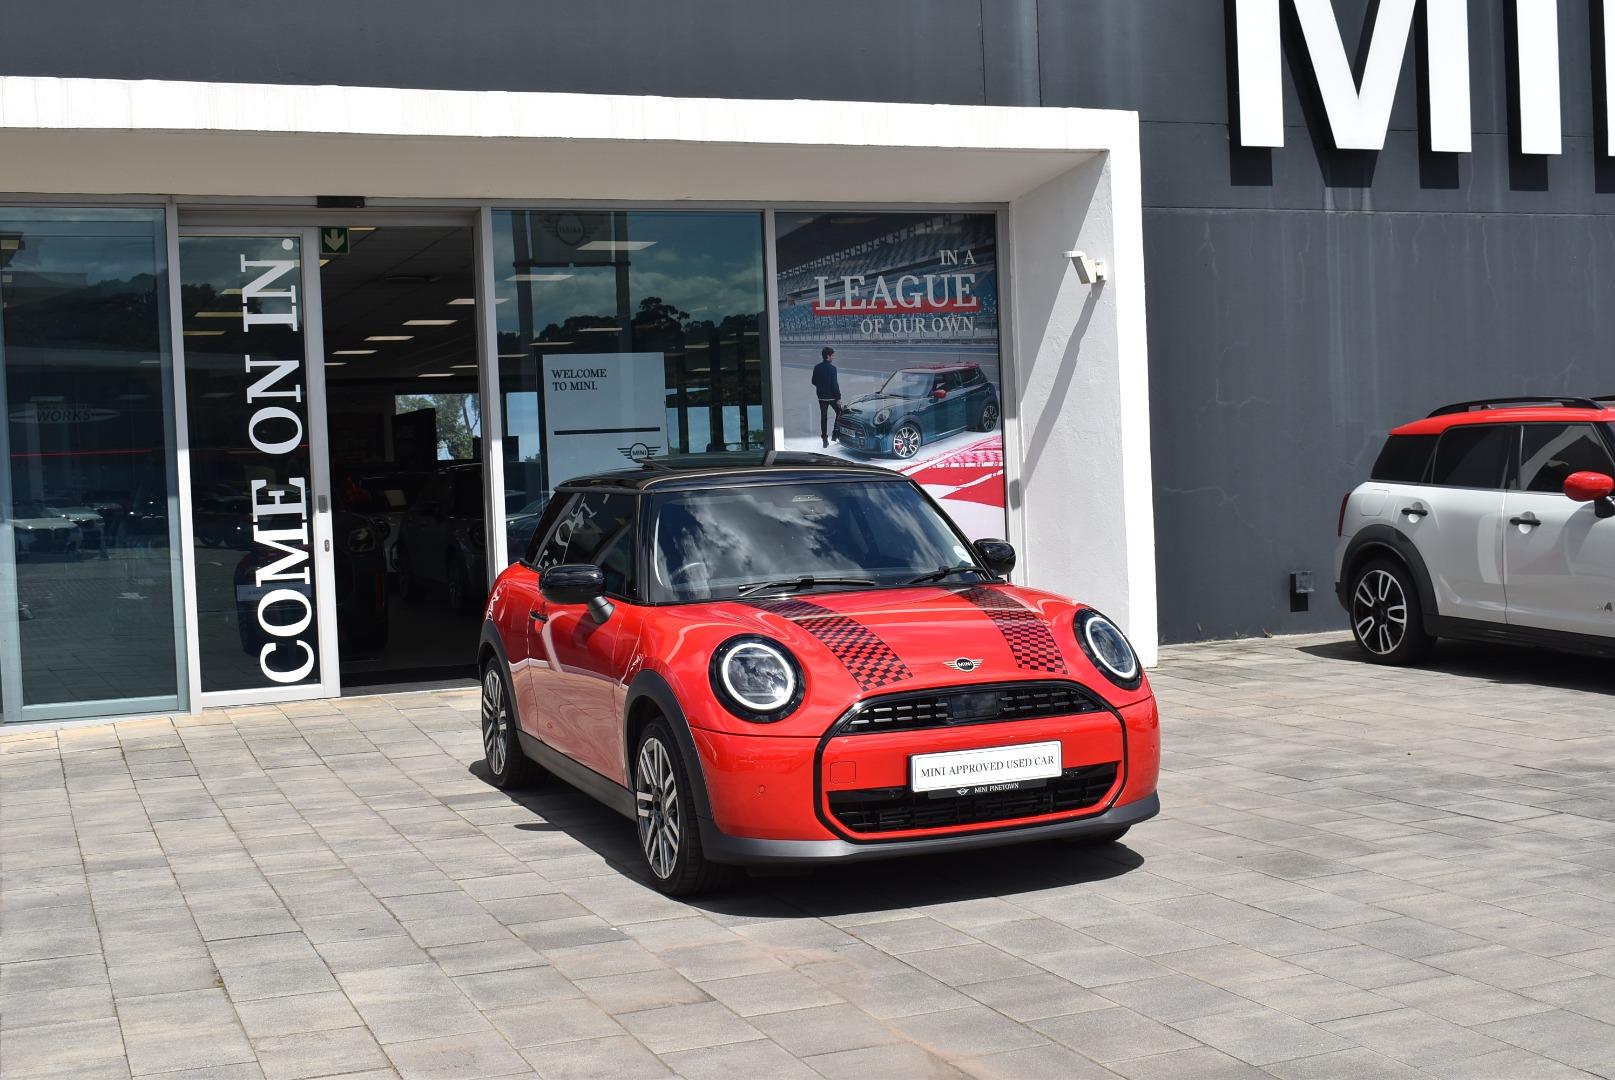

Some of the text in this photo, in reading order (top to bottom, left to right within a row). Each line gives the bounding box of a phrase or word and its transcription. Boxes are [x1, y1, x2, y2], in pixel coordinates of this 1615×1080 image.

[1236, 0, 1615, 157] MI
[939, 250, 976, 266] IN A
[240, 238, 297, 332] IN.
[814, 273, 977, 311] LEAGUE
[860, 316, 979, 335] OF OUR OWN.
[552, 368, 607, 379] WELCOME
[552, 380, 598, 391] TO MINI.
[37, 407, 92, 422] WORKS
[245, 354, 302, 455] ON
[252, 477, 314, 684] COME
[920, 755, 1054, 778] MINI APPROVED USED CAR
[974, 782, 1019, 794] MINI PINETOWN
